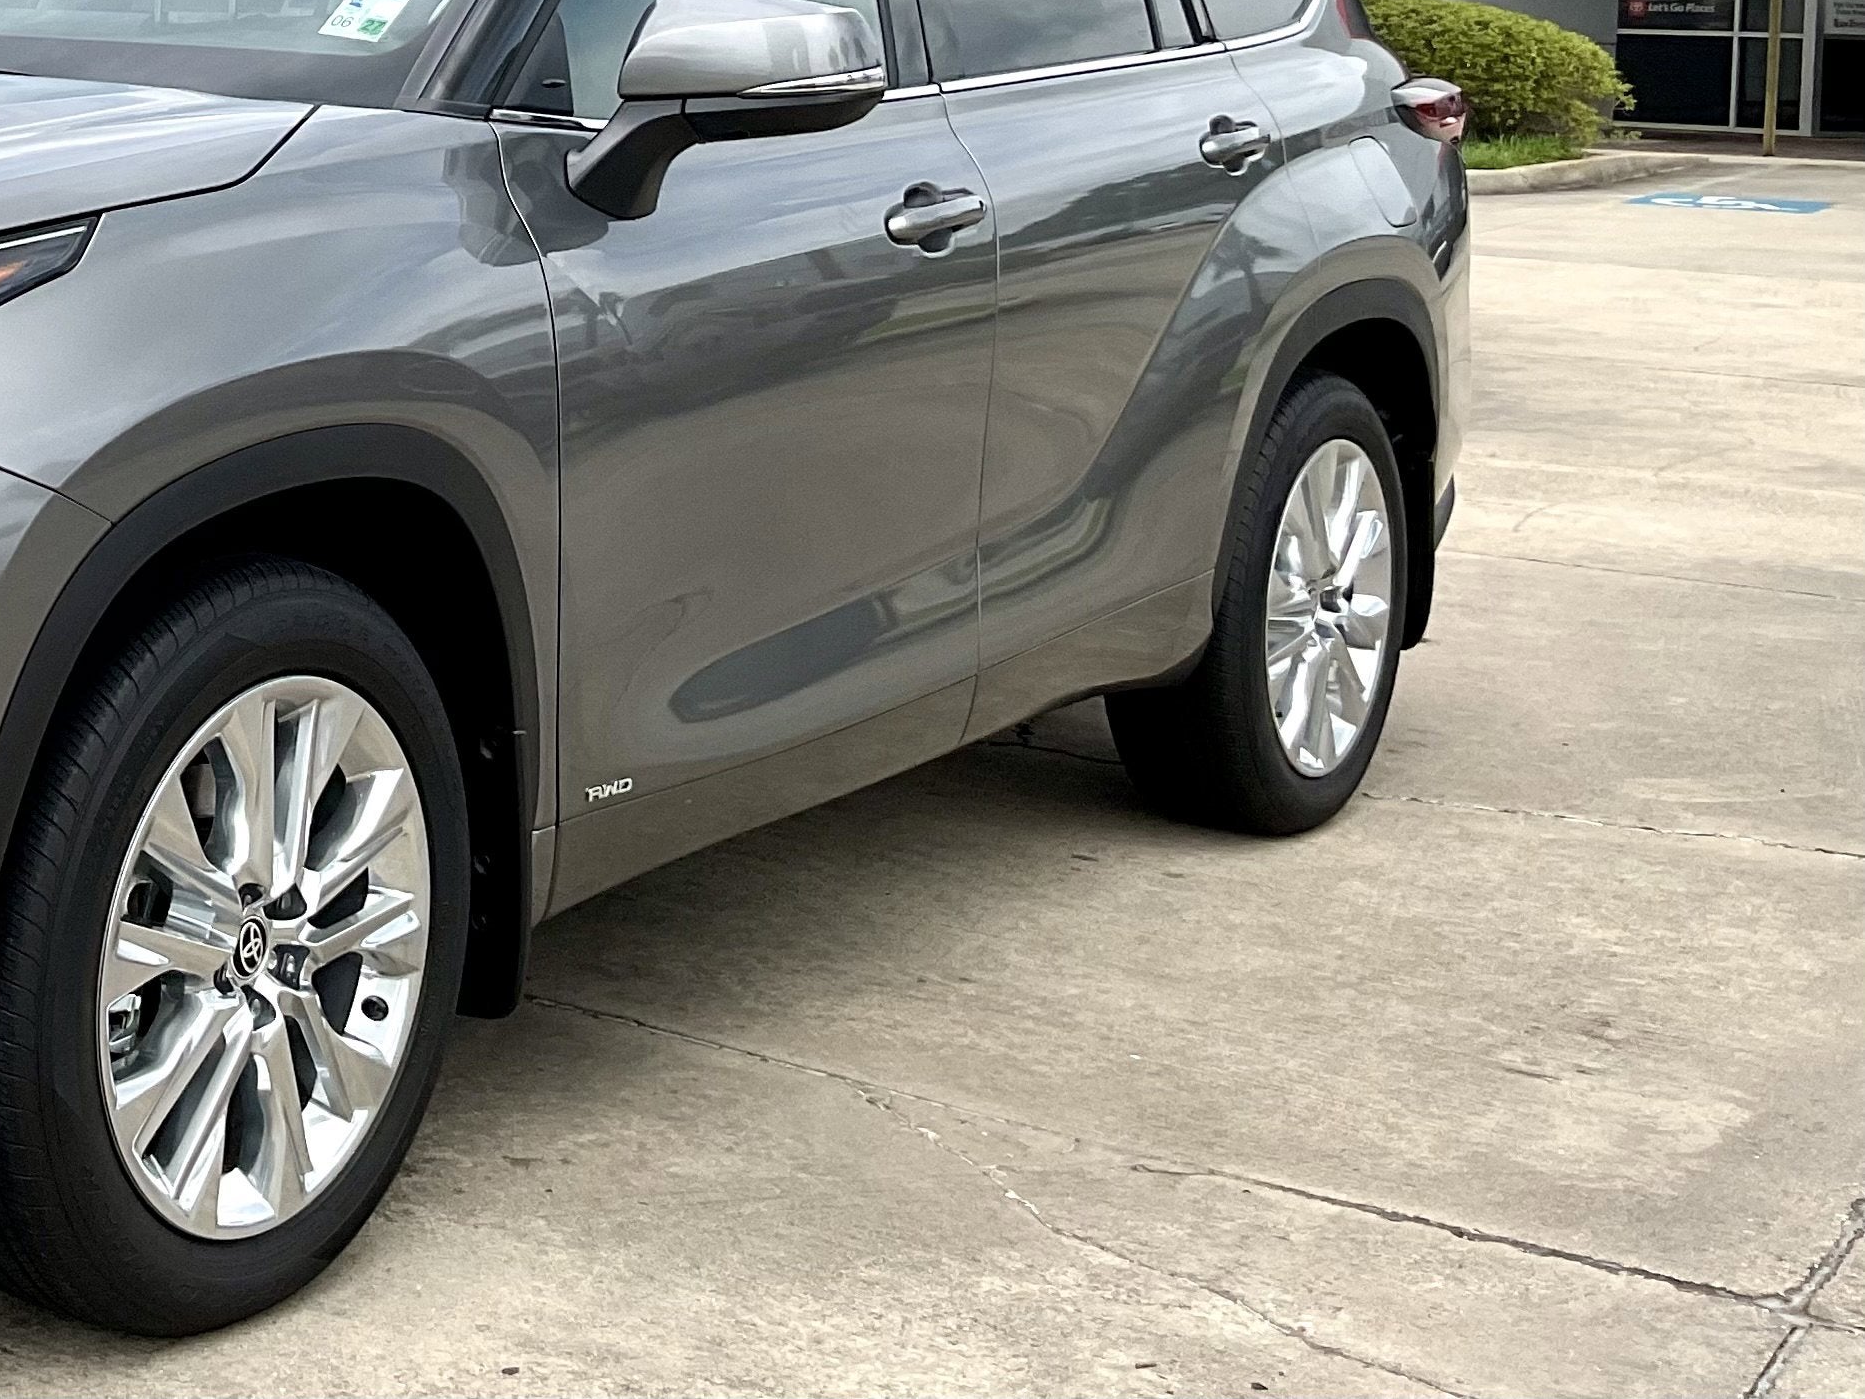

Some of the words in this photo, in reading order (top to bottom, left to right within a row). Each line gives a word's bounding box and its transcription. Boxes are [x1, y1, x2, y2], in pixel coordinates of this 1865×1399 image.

[1670, 2, 1684, 12] Go
[330, 14, 355, 28] 06
[359, 18, 387, 33] 27
[585, 777, 634, 803] AWD
